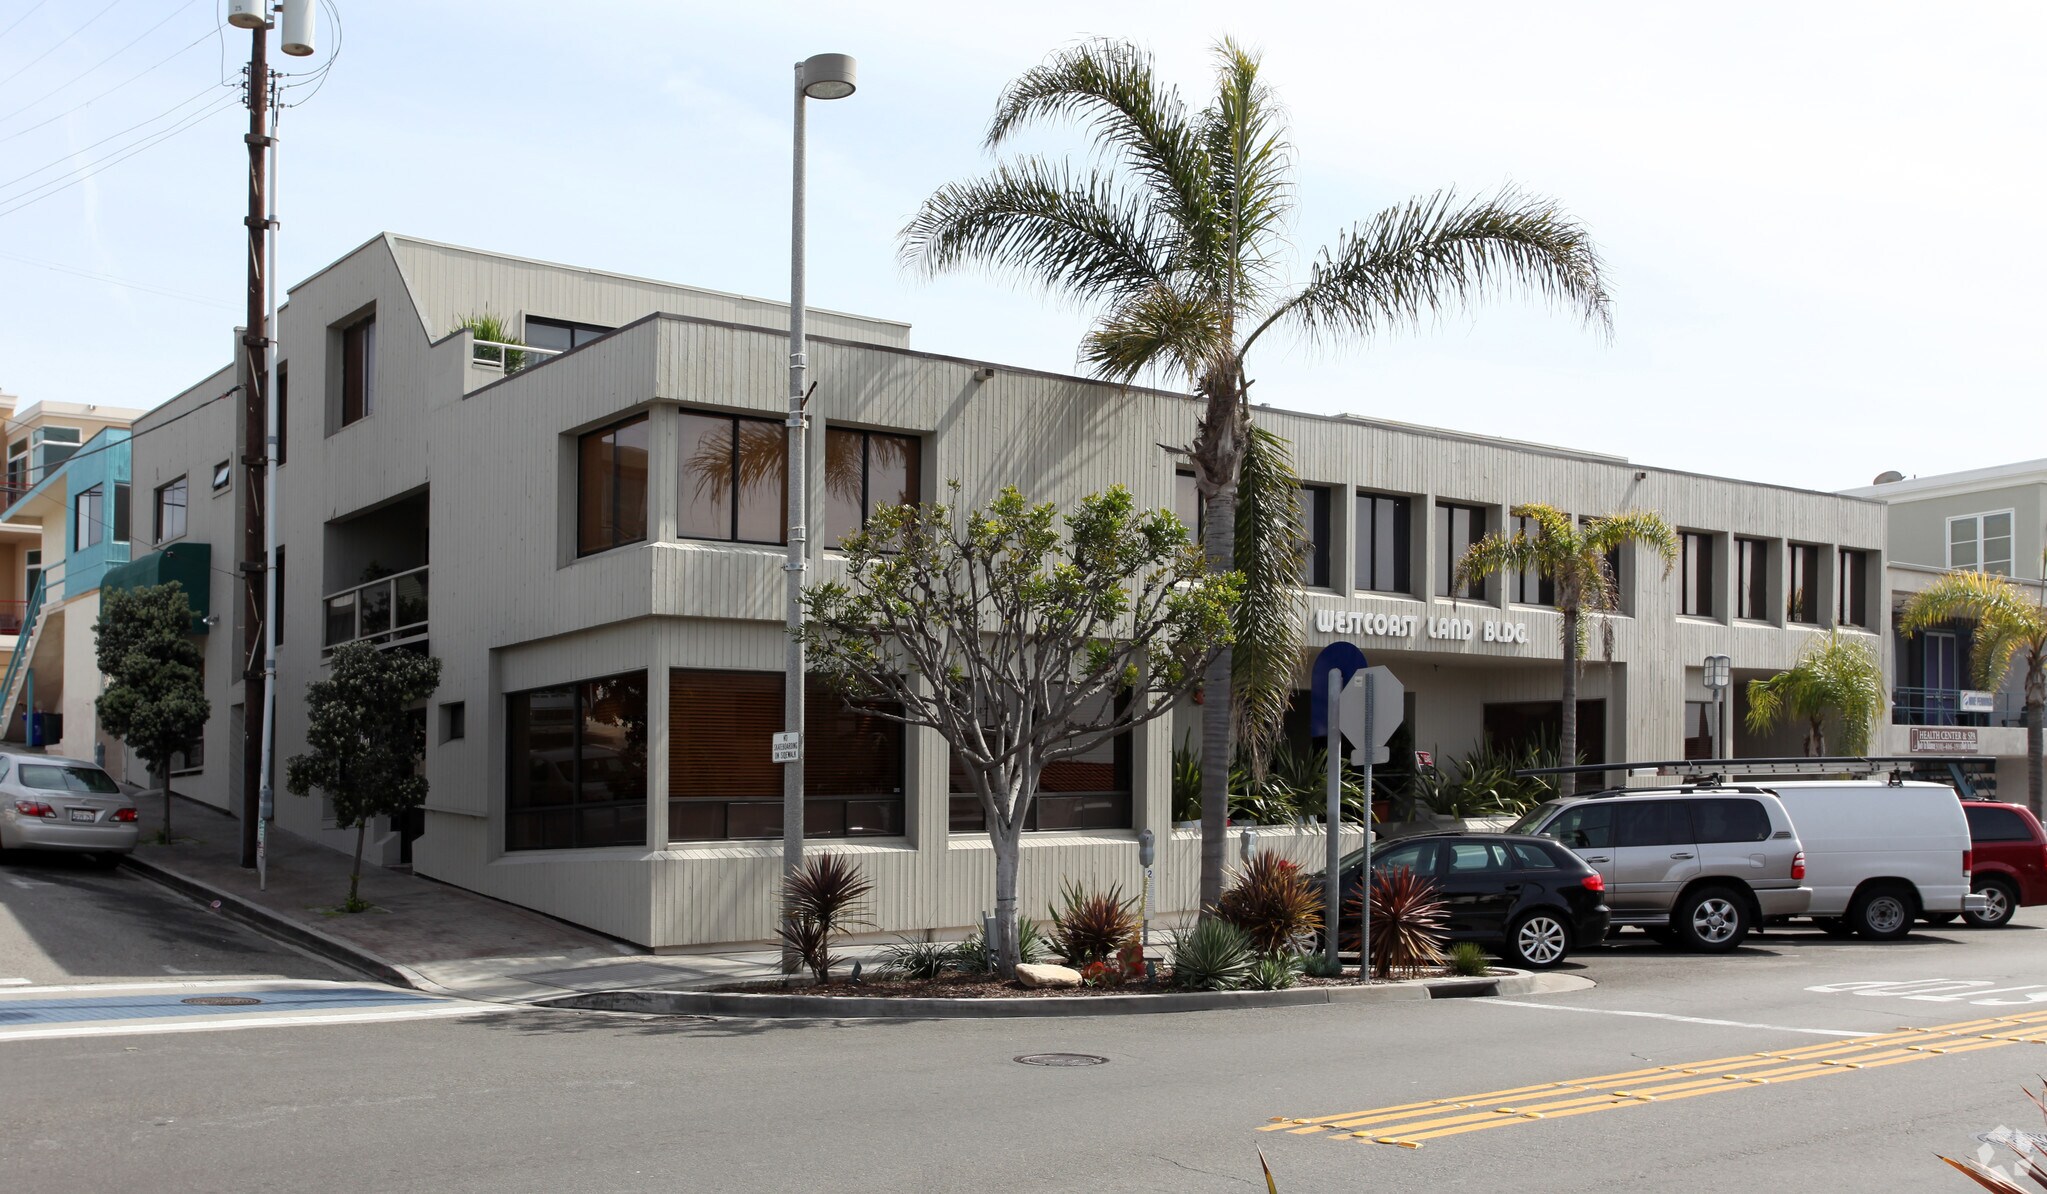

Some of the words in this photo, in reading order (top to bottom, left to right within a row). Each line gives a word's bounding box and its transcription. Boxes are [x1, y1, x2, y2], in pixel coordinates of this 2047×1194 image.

[1315, 609, 1418, 637] WESTCOAST
[1427, 617, 1474, 641] LAND
[1919, 730, 1940, 739] HEALTH
[1940, 731, 1961, 740] CENTER
[1967, 731, 1976, 740] SPA
[1147, 869, 1152, 878] 2
